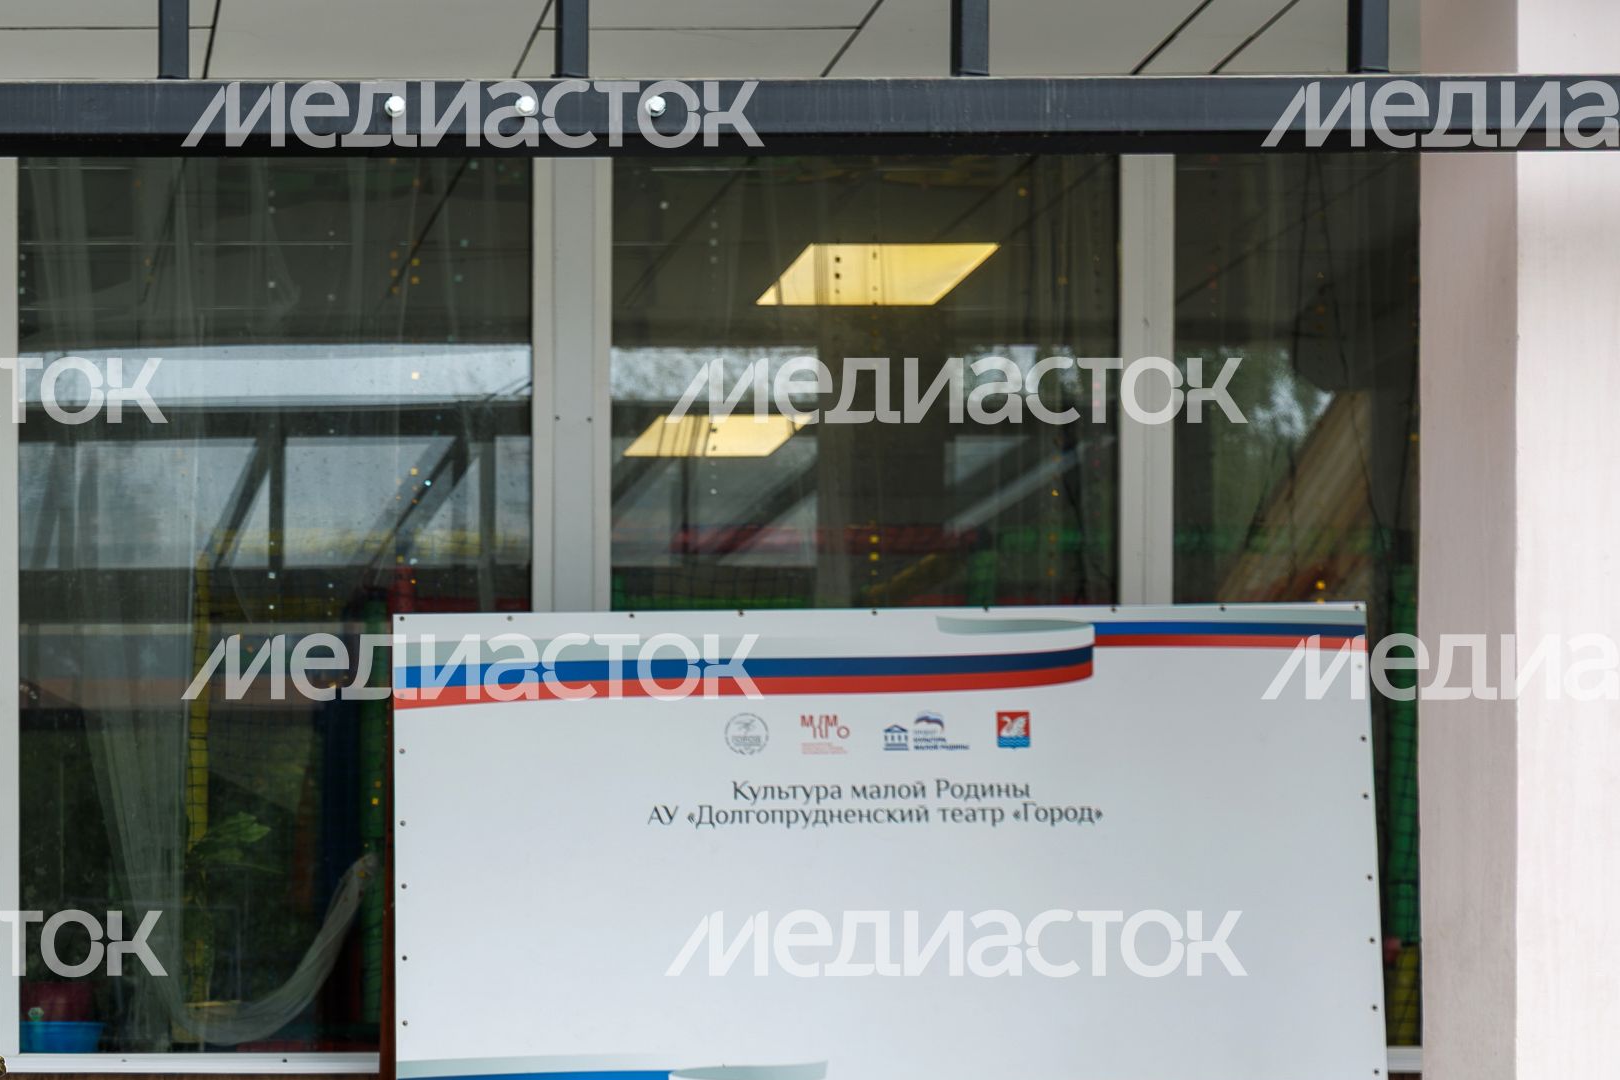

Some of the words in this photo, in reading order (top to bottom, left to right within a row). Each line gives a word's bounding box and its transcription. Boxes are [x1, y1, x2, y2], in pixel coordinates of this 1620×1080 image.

[732, 781, 842, 805] Культура
[851, 782, 926, 800] малой
[935, 778, 1031, 801] Родины
[647, 805, 679, 825] АУ
[687, 804, 929, 830] «Долгопрудненский
[937, 806, 1005, 827] театр
[1012, 802, 1104, 826] «Город»
